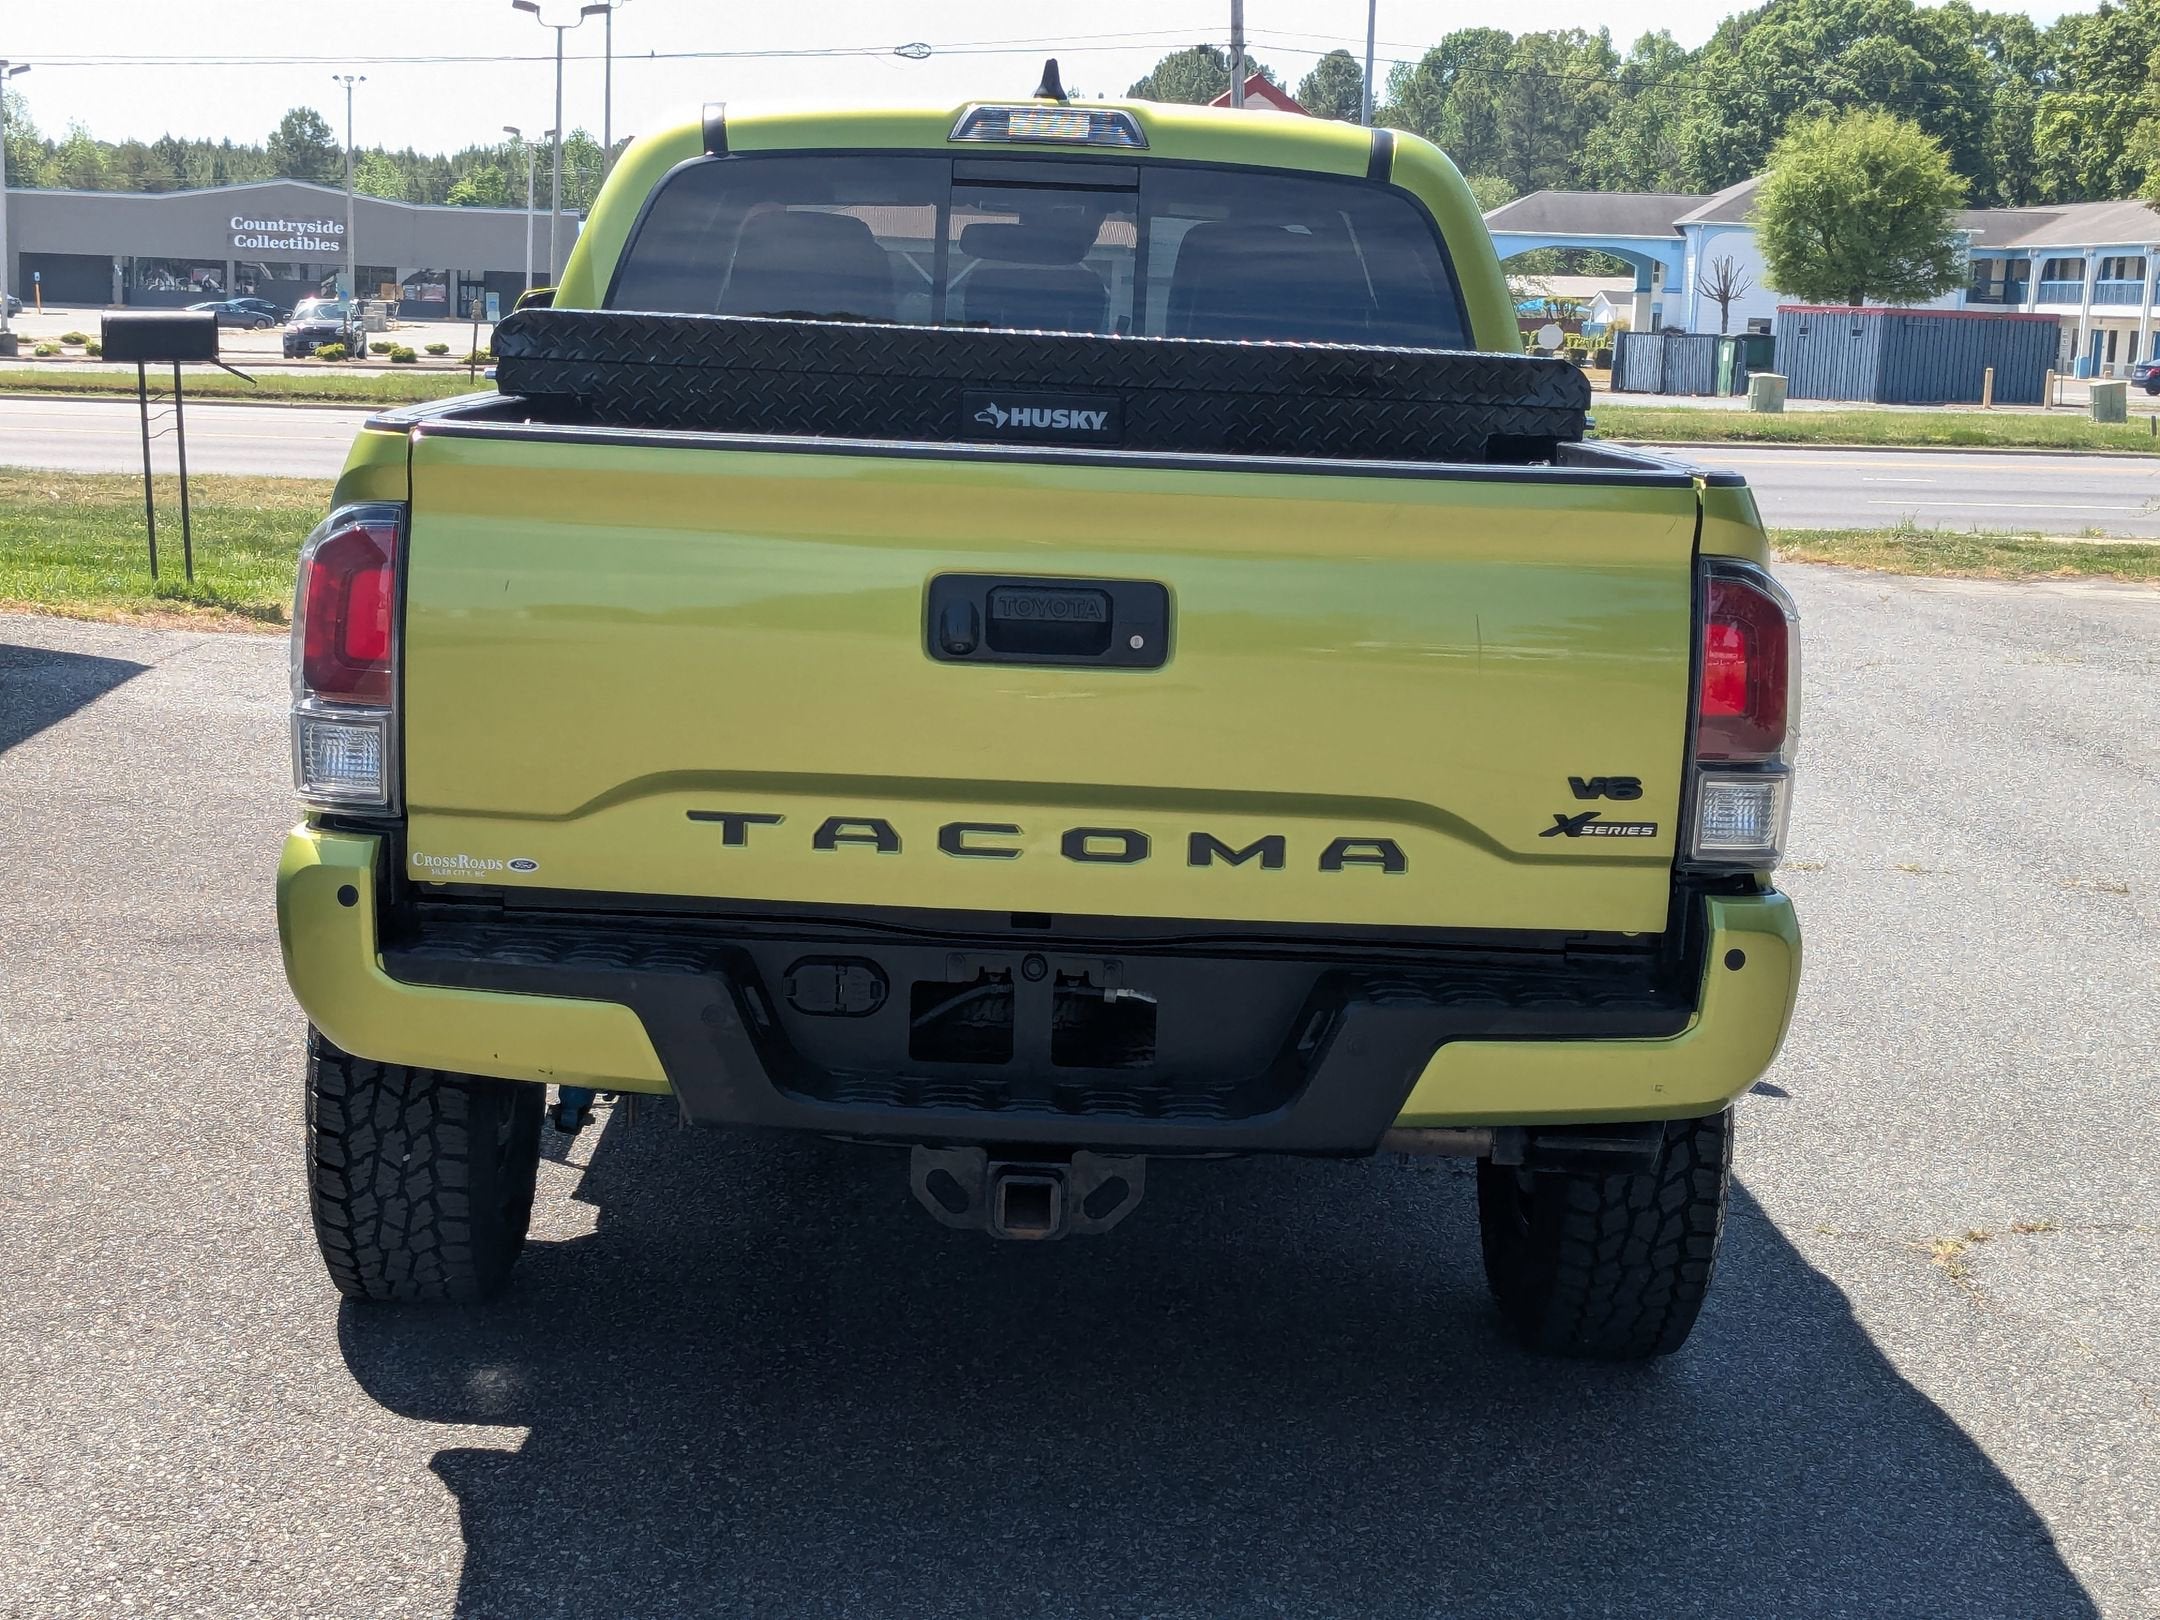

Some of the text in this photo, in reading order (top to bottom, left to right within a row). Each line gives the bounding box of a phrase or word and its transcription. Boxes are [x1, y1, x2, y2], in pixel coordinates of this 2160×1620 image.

[230, 216, 344, 235] Countryside
[234, 235, 340, 251] Collectibles
[1010, 407, 1108, 430] HUSKY
[1000, 598, 1101, 618] TOYOTA
[1568, 776, 1643, 800] V6
[1581, 826, 1654, 835] SERIES
[686, 810, 1408, 874] TACOMA
